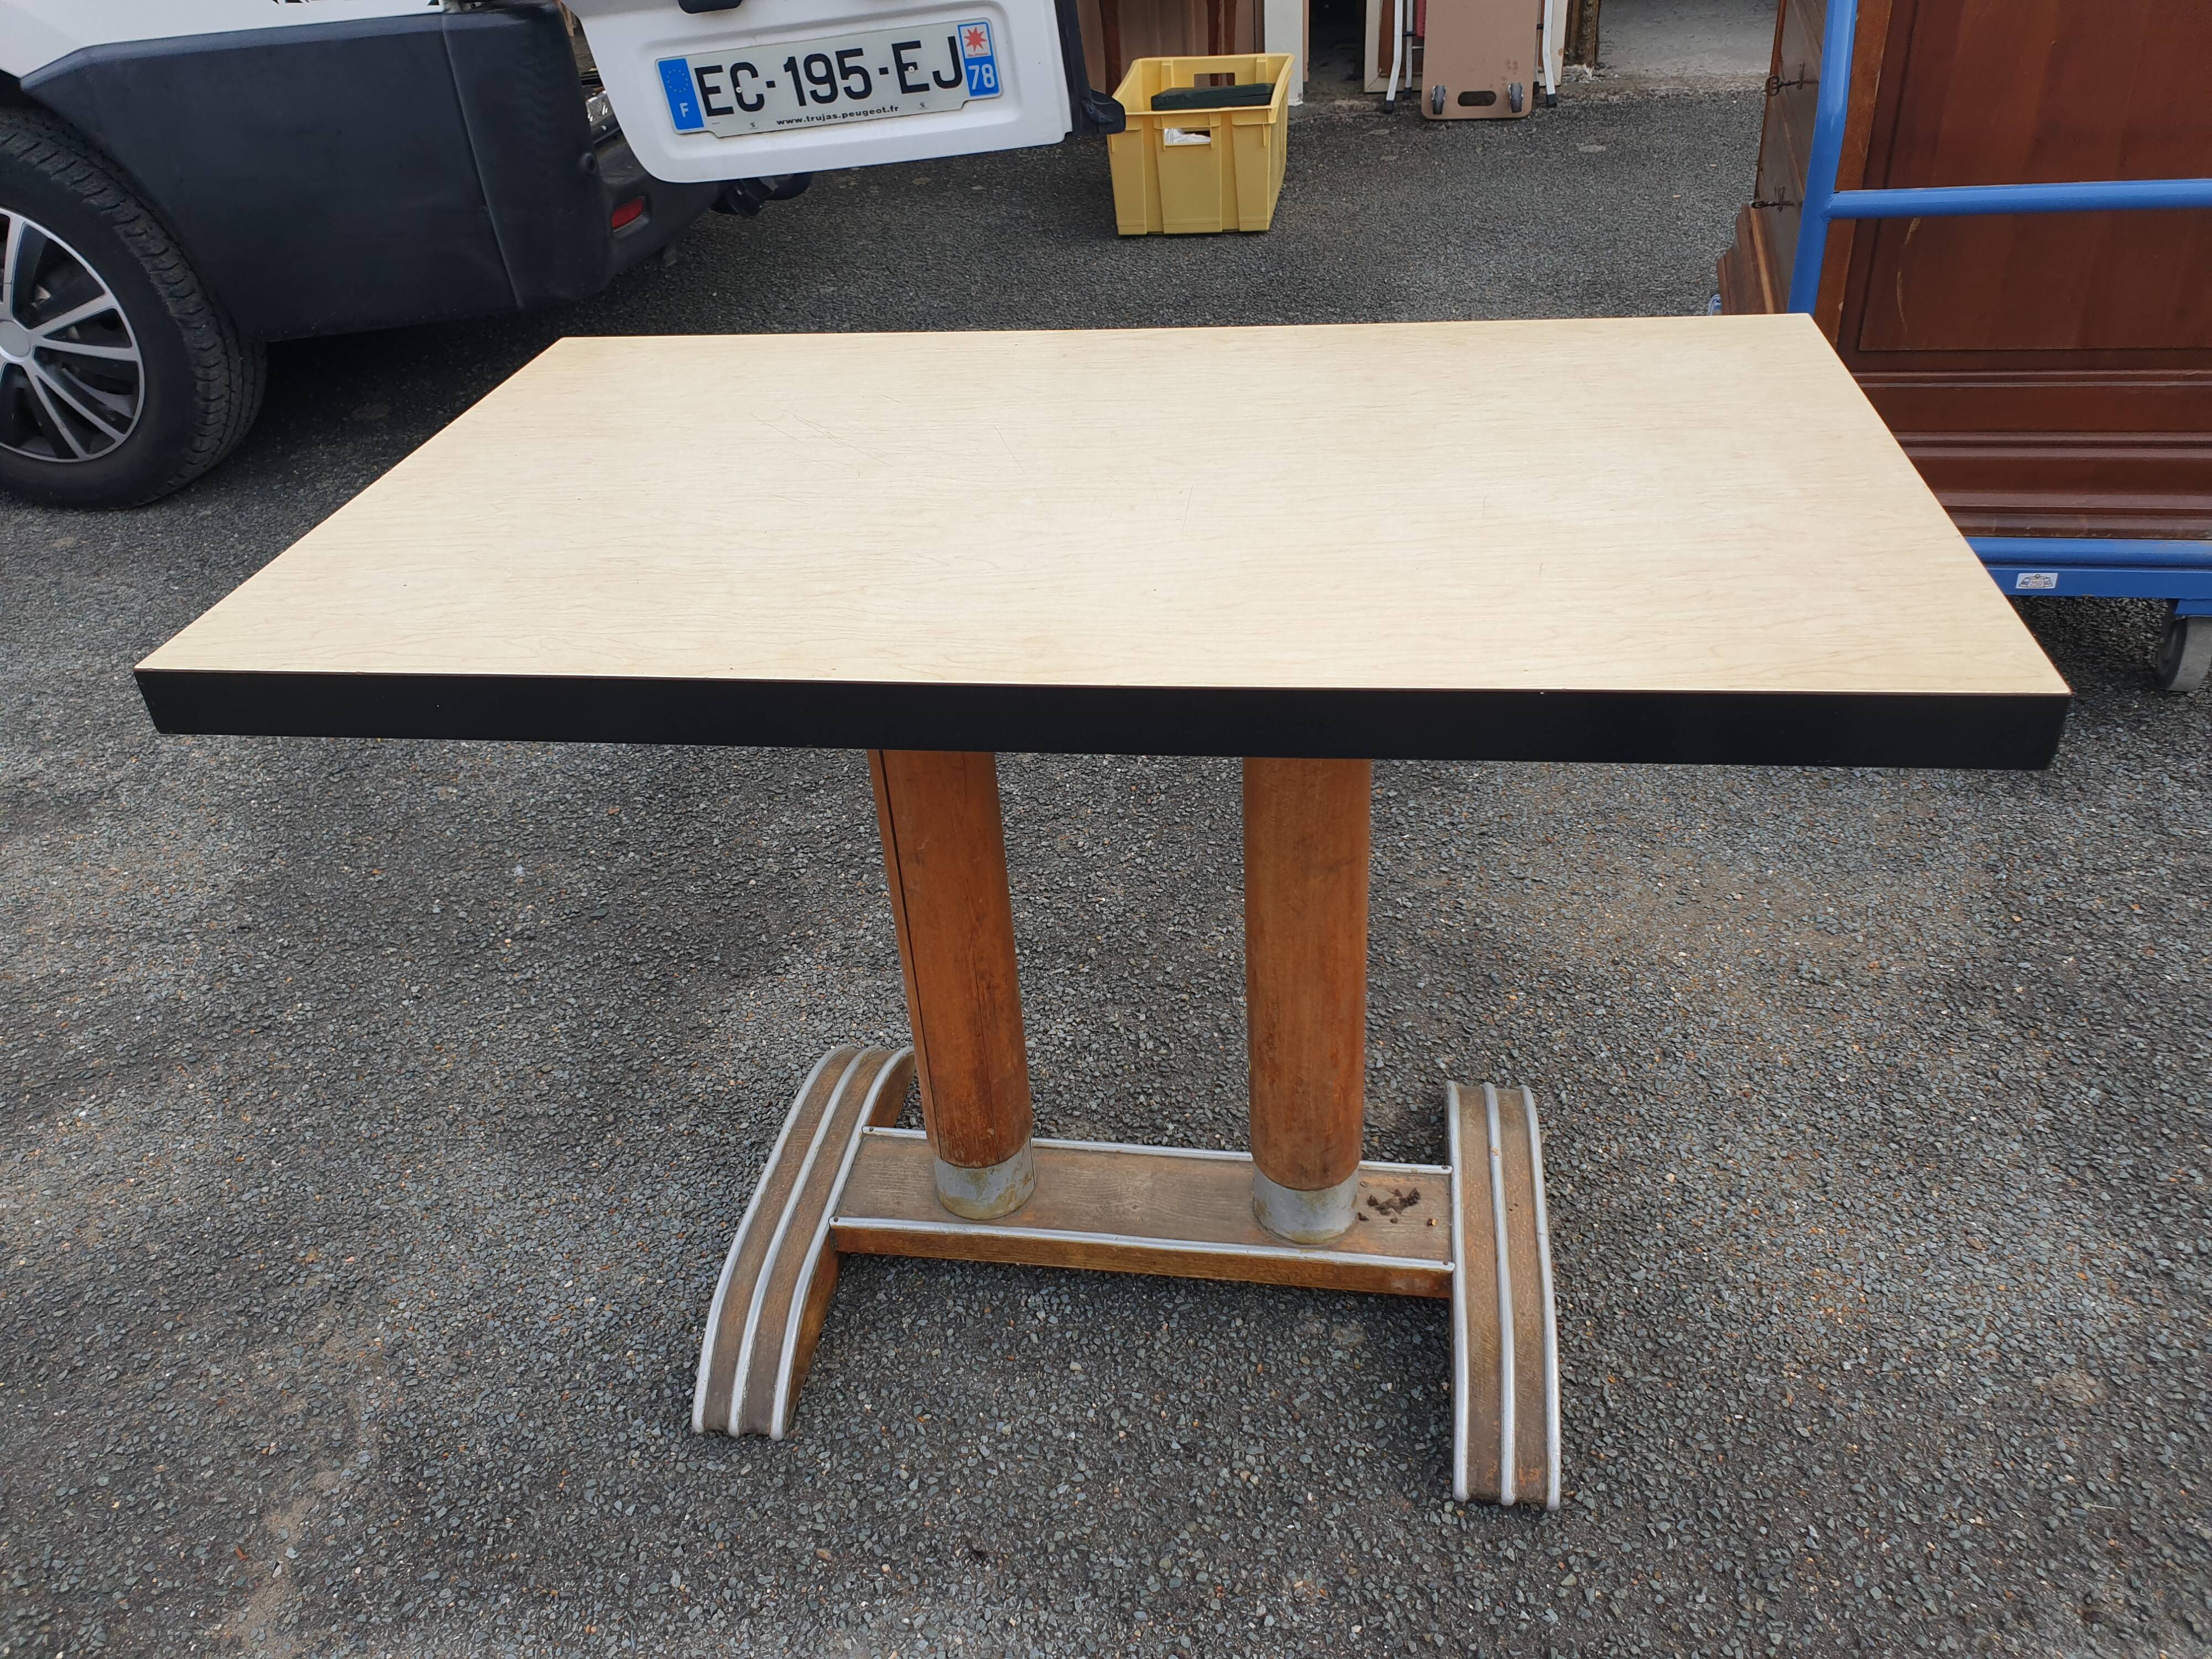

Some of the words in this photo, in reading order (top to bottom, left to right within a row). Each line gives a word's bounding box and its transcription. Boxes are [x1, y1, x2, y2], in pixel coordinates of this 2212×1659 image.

[694, 36, 962, 117] EC-195-EJ
[968, 64, 995, 90] 78
[680, 103, 689, 118] F
[776, 105, 899, 126] www.trujas.peugeot.fr
